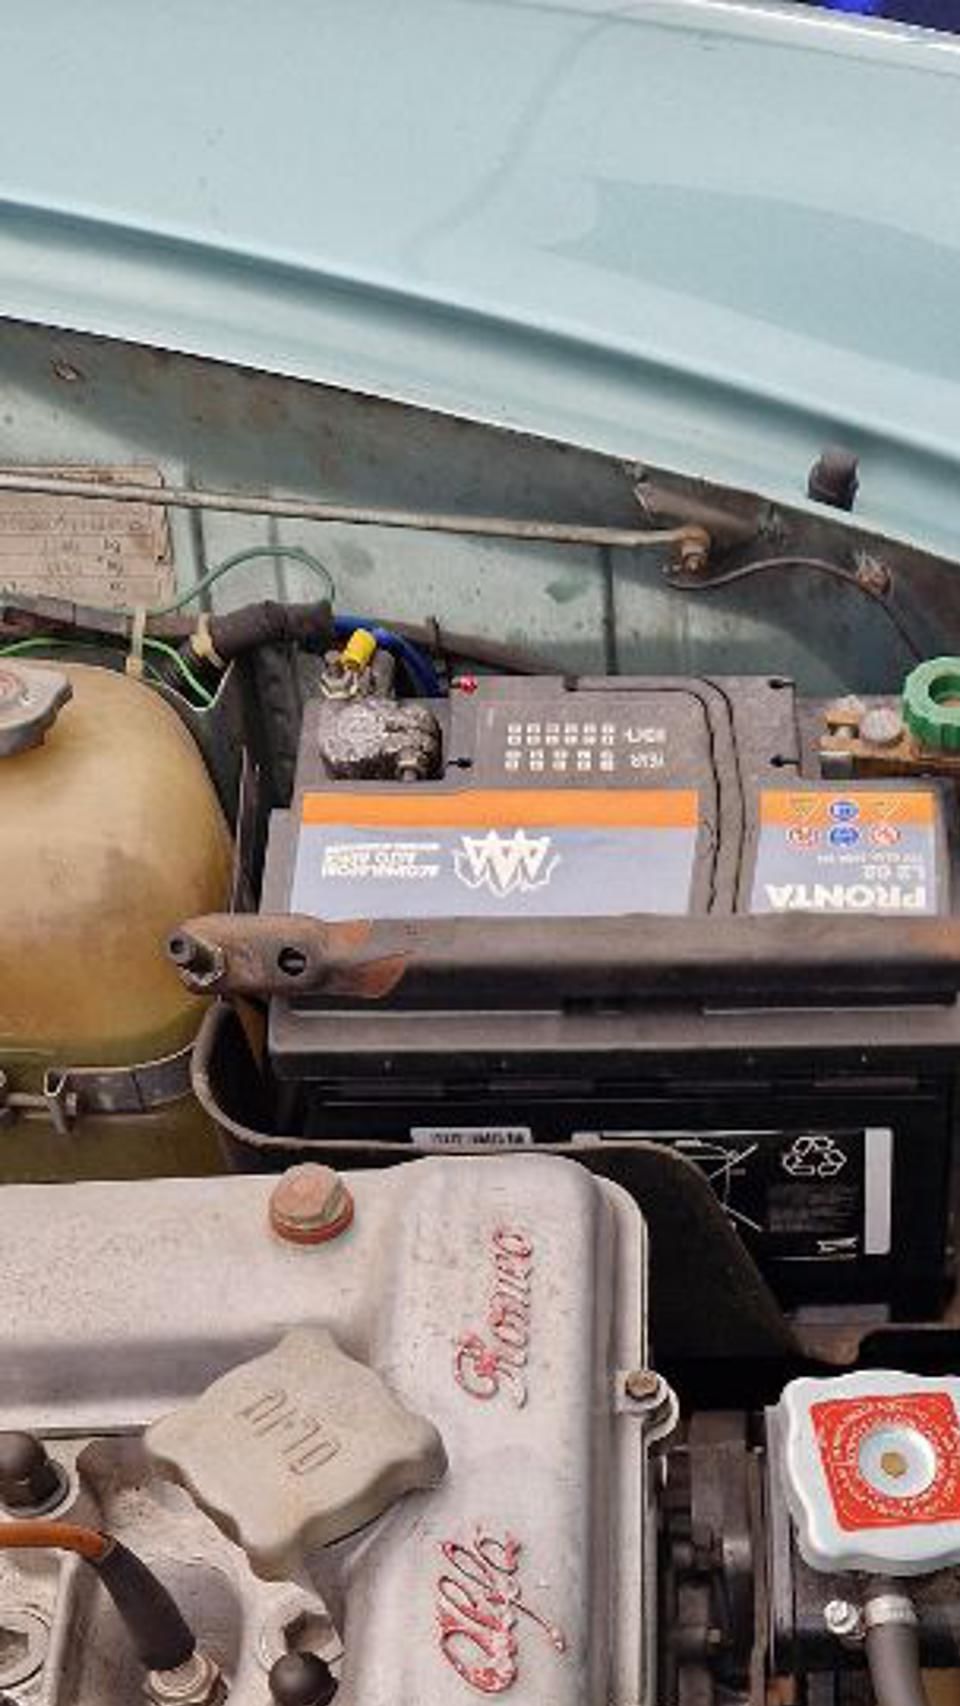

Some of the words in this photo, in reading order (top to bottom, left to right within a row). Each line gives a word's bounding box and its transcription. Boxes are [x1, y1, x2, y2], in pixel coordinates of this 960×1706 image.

[764, 883, 927, 910] PRONTA
[451, 1225, 534, 1410] Romeo
[434, 1524, 568, 1696] Alfa
